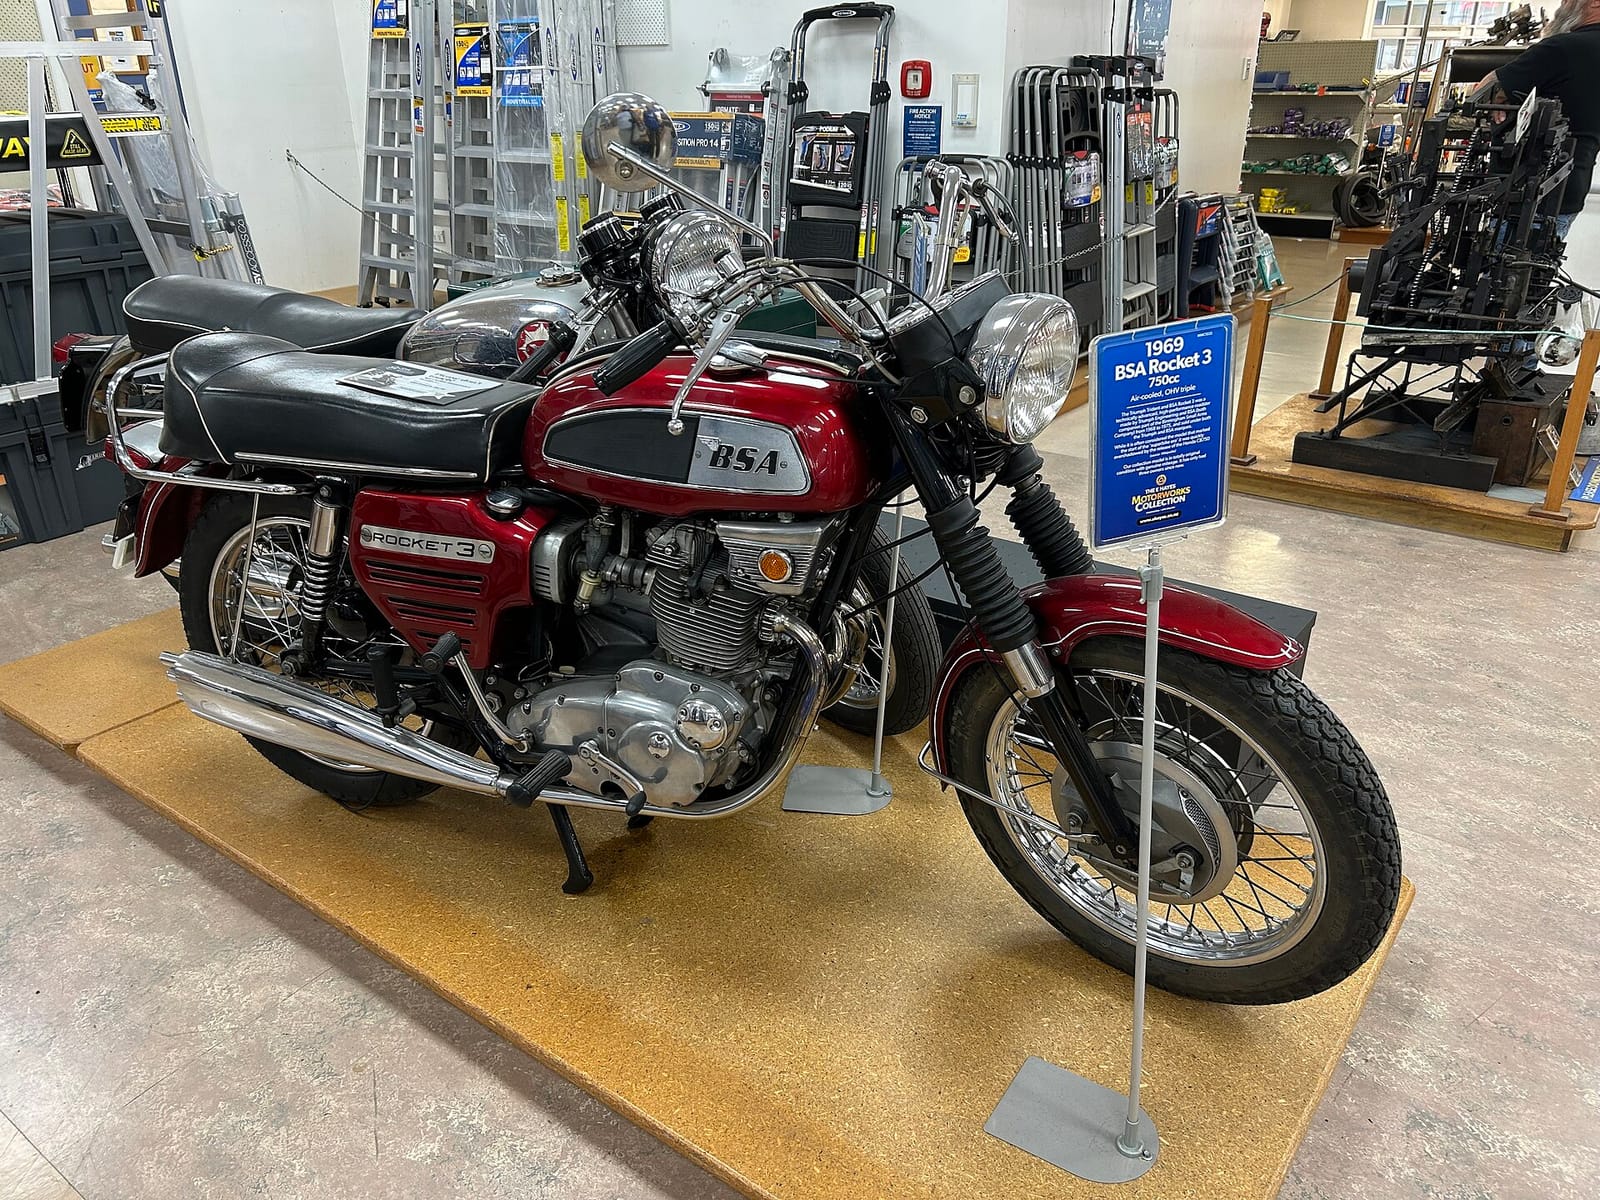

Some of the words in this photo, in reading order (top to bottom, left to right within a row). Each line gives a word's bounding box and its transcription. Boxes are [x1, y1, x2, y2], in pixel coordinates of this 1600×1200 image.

[696, 138, 708, 148] PRO
[709, 139, 719, 148] 14
[1145, 336, 1184, 357] 1969
[1115, 361, 1147, 381] BSA
[1149, 351, 1200, 375] Rocket
[1202, 348, 1212, 365] 3
[1148, 373, 1180, 388] 750cc
[1130, 390, 1163, 403] Air-cooled,
[1164, 386, 1180, 396] OHV
[1181, 383, 1196, 393] triple
[708, 443, 779, 476] BSA
[1132, 486, 1191, 505] MOTORWORKS
[1159, 483, 1176, 491] HAYES
[1135, 495, 1186, 513] COLLECTION
[372, 532, 454, 553] ROCKET
[456, 541, 476, 558] 3
